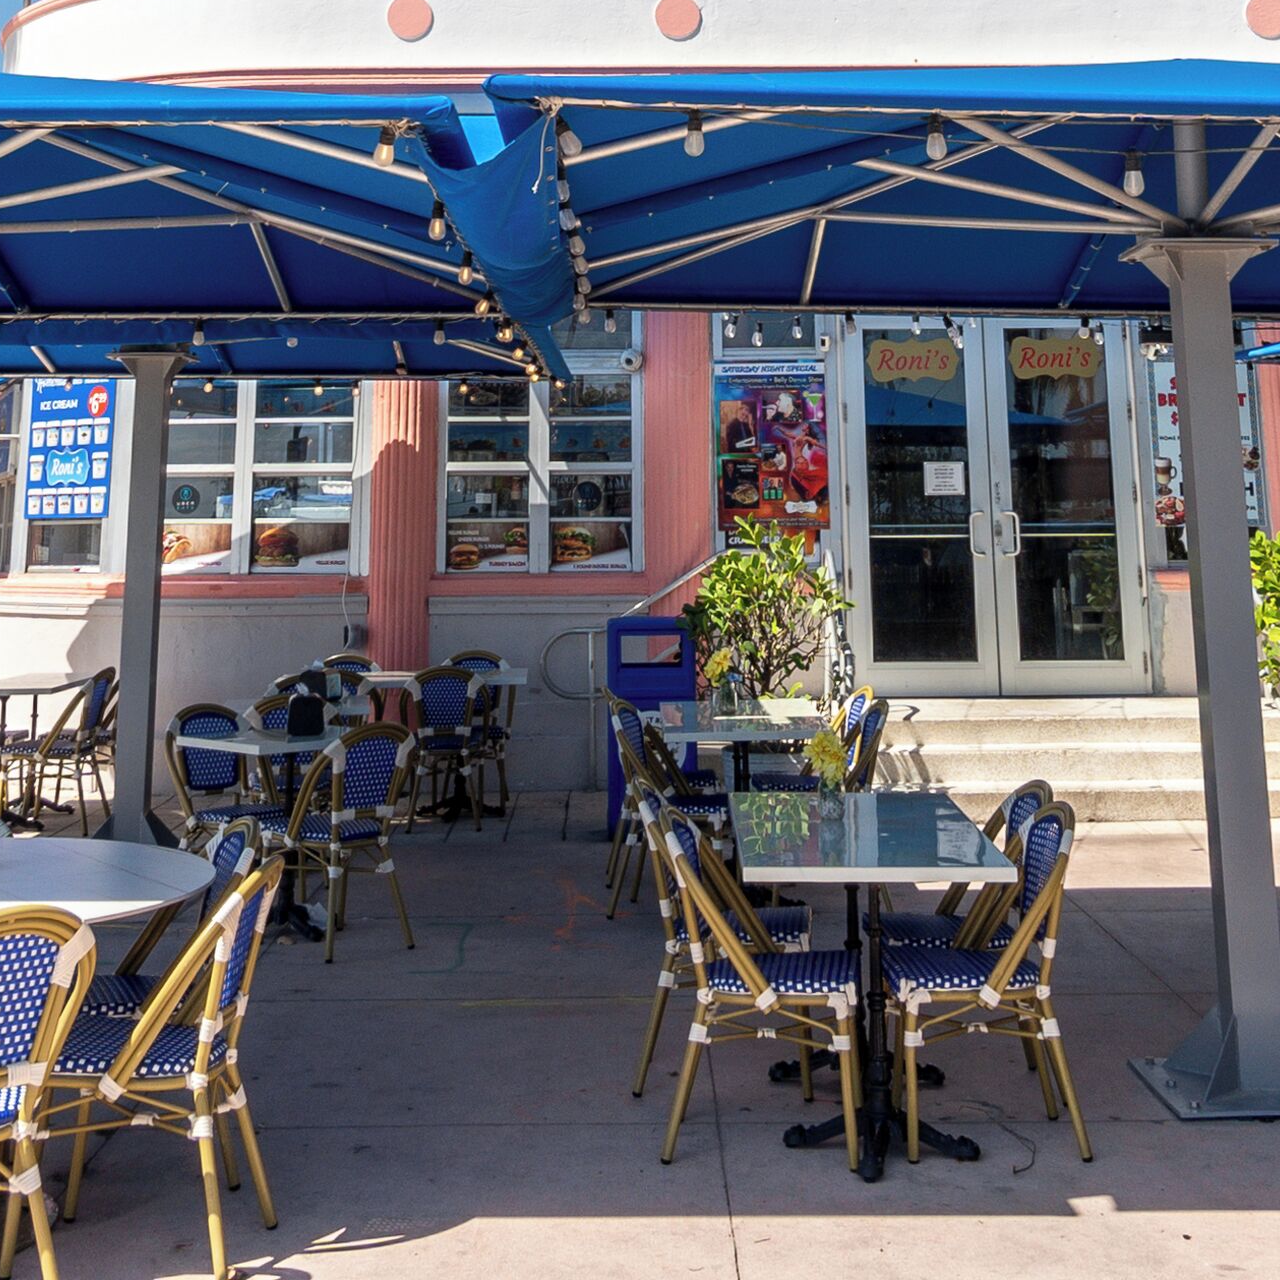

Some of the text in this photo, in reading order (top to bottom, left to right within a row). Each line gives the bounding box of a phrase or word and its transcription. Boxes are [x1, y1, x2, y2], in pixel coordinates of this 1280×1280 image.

[877, 348, 949, 371] Roni's
[1019, 346, 1091, 369] Roni's
[761, 365, 786, 373] NIGHT
[40, 399, 79, 411] ICE CREAM
[51, 456, 83, 476] Roni's
